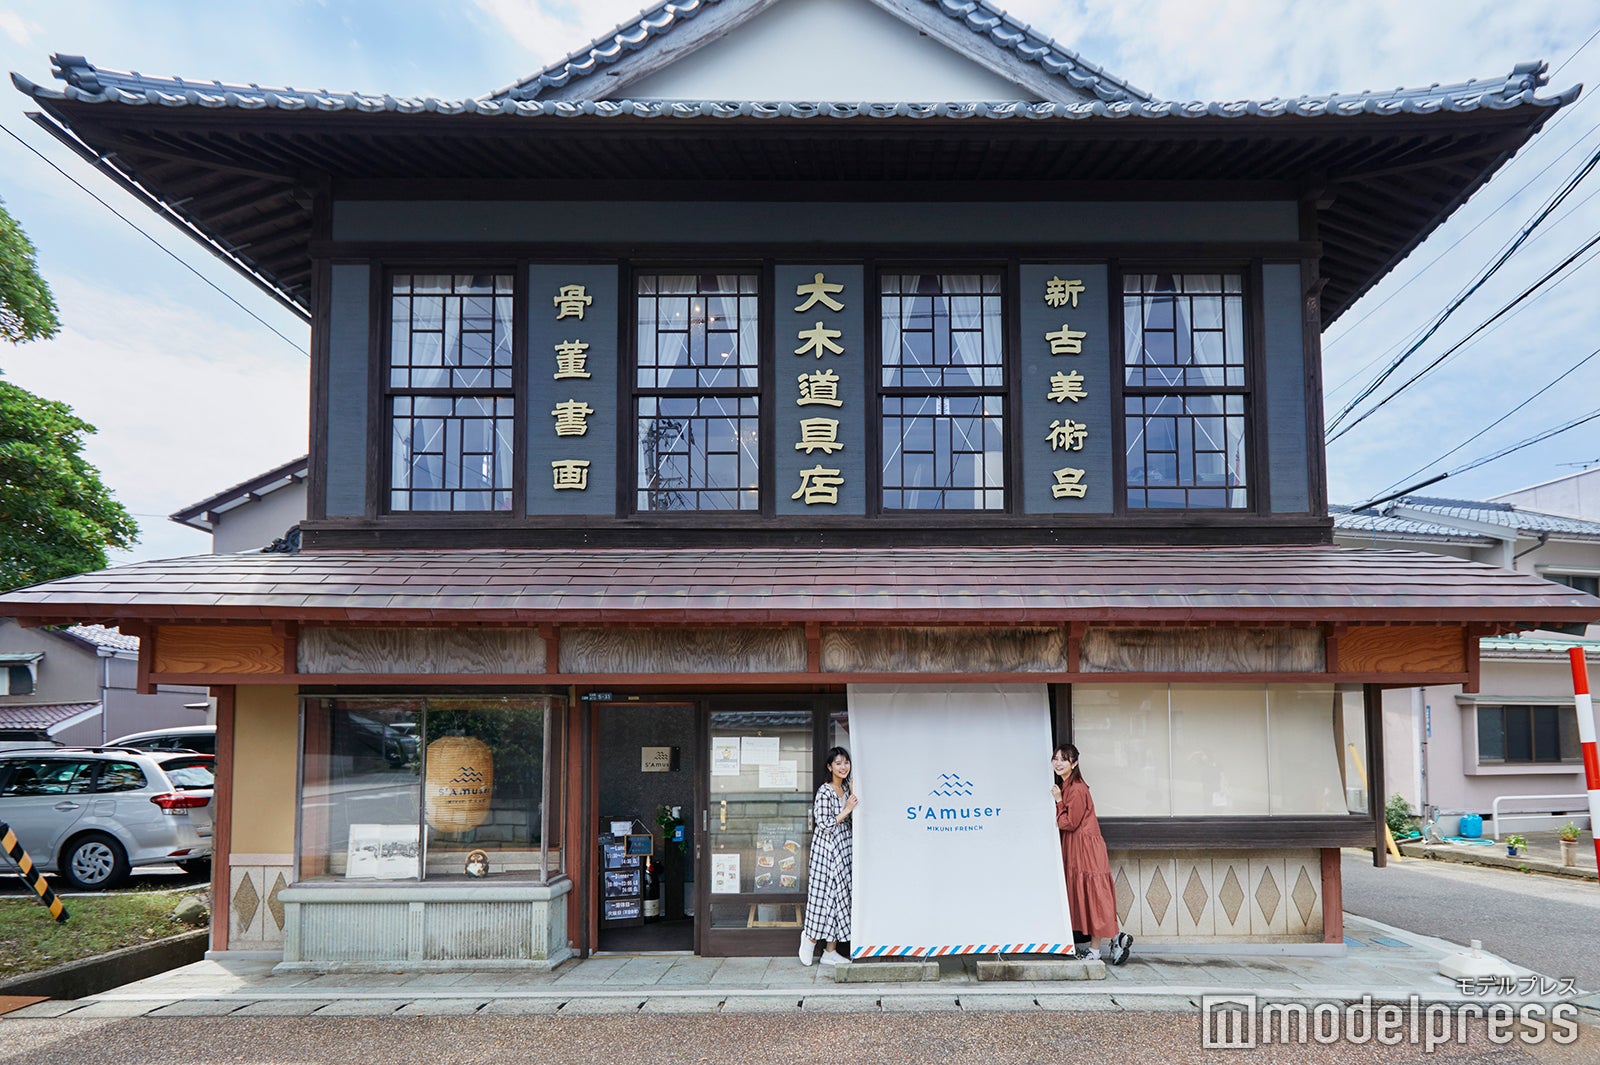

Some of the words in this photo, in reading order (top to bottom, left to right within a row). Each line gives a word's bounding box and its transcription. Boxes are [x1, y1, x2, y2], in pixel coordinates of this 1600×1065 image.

[551, 283, 595, 492] 骨董書画
[791, 271, 846, 506] 大木道具店
[907, 805, 1001, 820] S'Amuser
